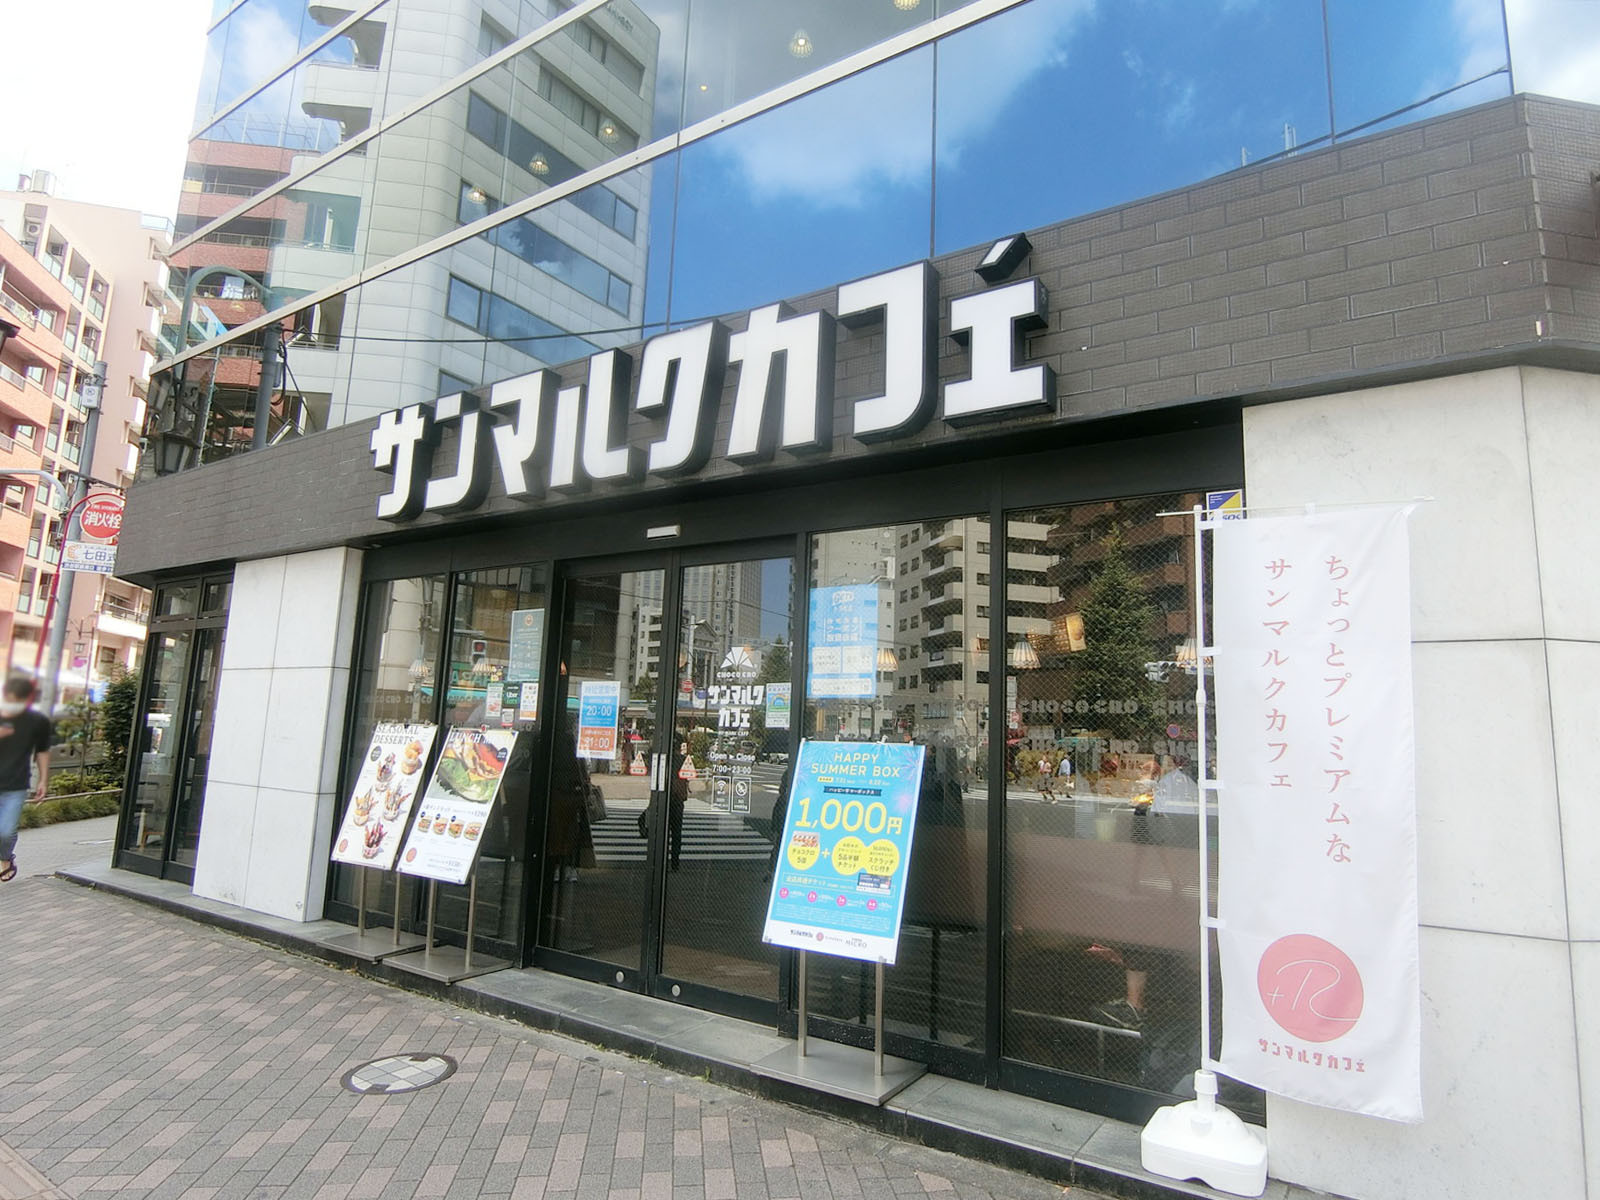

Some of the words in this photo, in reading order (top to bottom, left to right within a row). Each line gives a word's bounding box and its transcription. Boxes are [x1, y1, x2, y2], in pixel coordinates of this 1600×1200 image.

[370, 233, 1053, 520] サンマルクカフェ
[84, 511, 122, 529] 消火栓
[1262, 557, 1293, 789] サンマルクカフェ
[708, 685, 764, 705] サンマルク
[719, 707, 750, 728] カフェ
[1323, 555, 1353, 863] ちょっとプレミアムな
[710, 752, 728, 760] Open
[736, 753, 756, 761] Close
[834, 752, 879, 764] HAPPY
[811, 763, 867, 776] SUMMER
[872, 766, 901, 778] BOX
[1258, 1037, 1366, 1073] サンマルクカフェ
